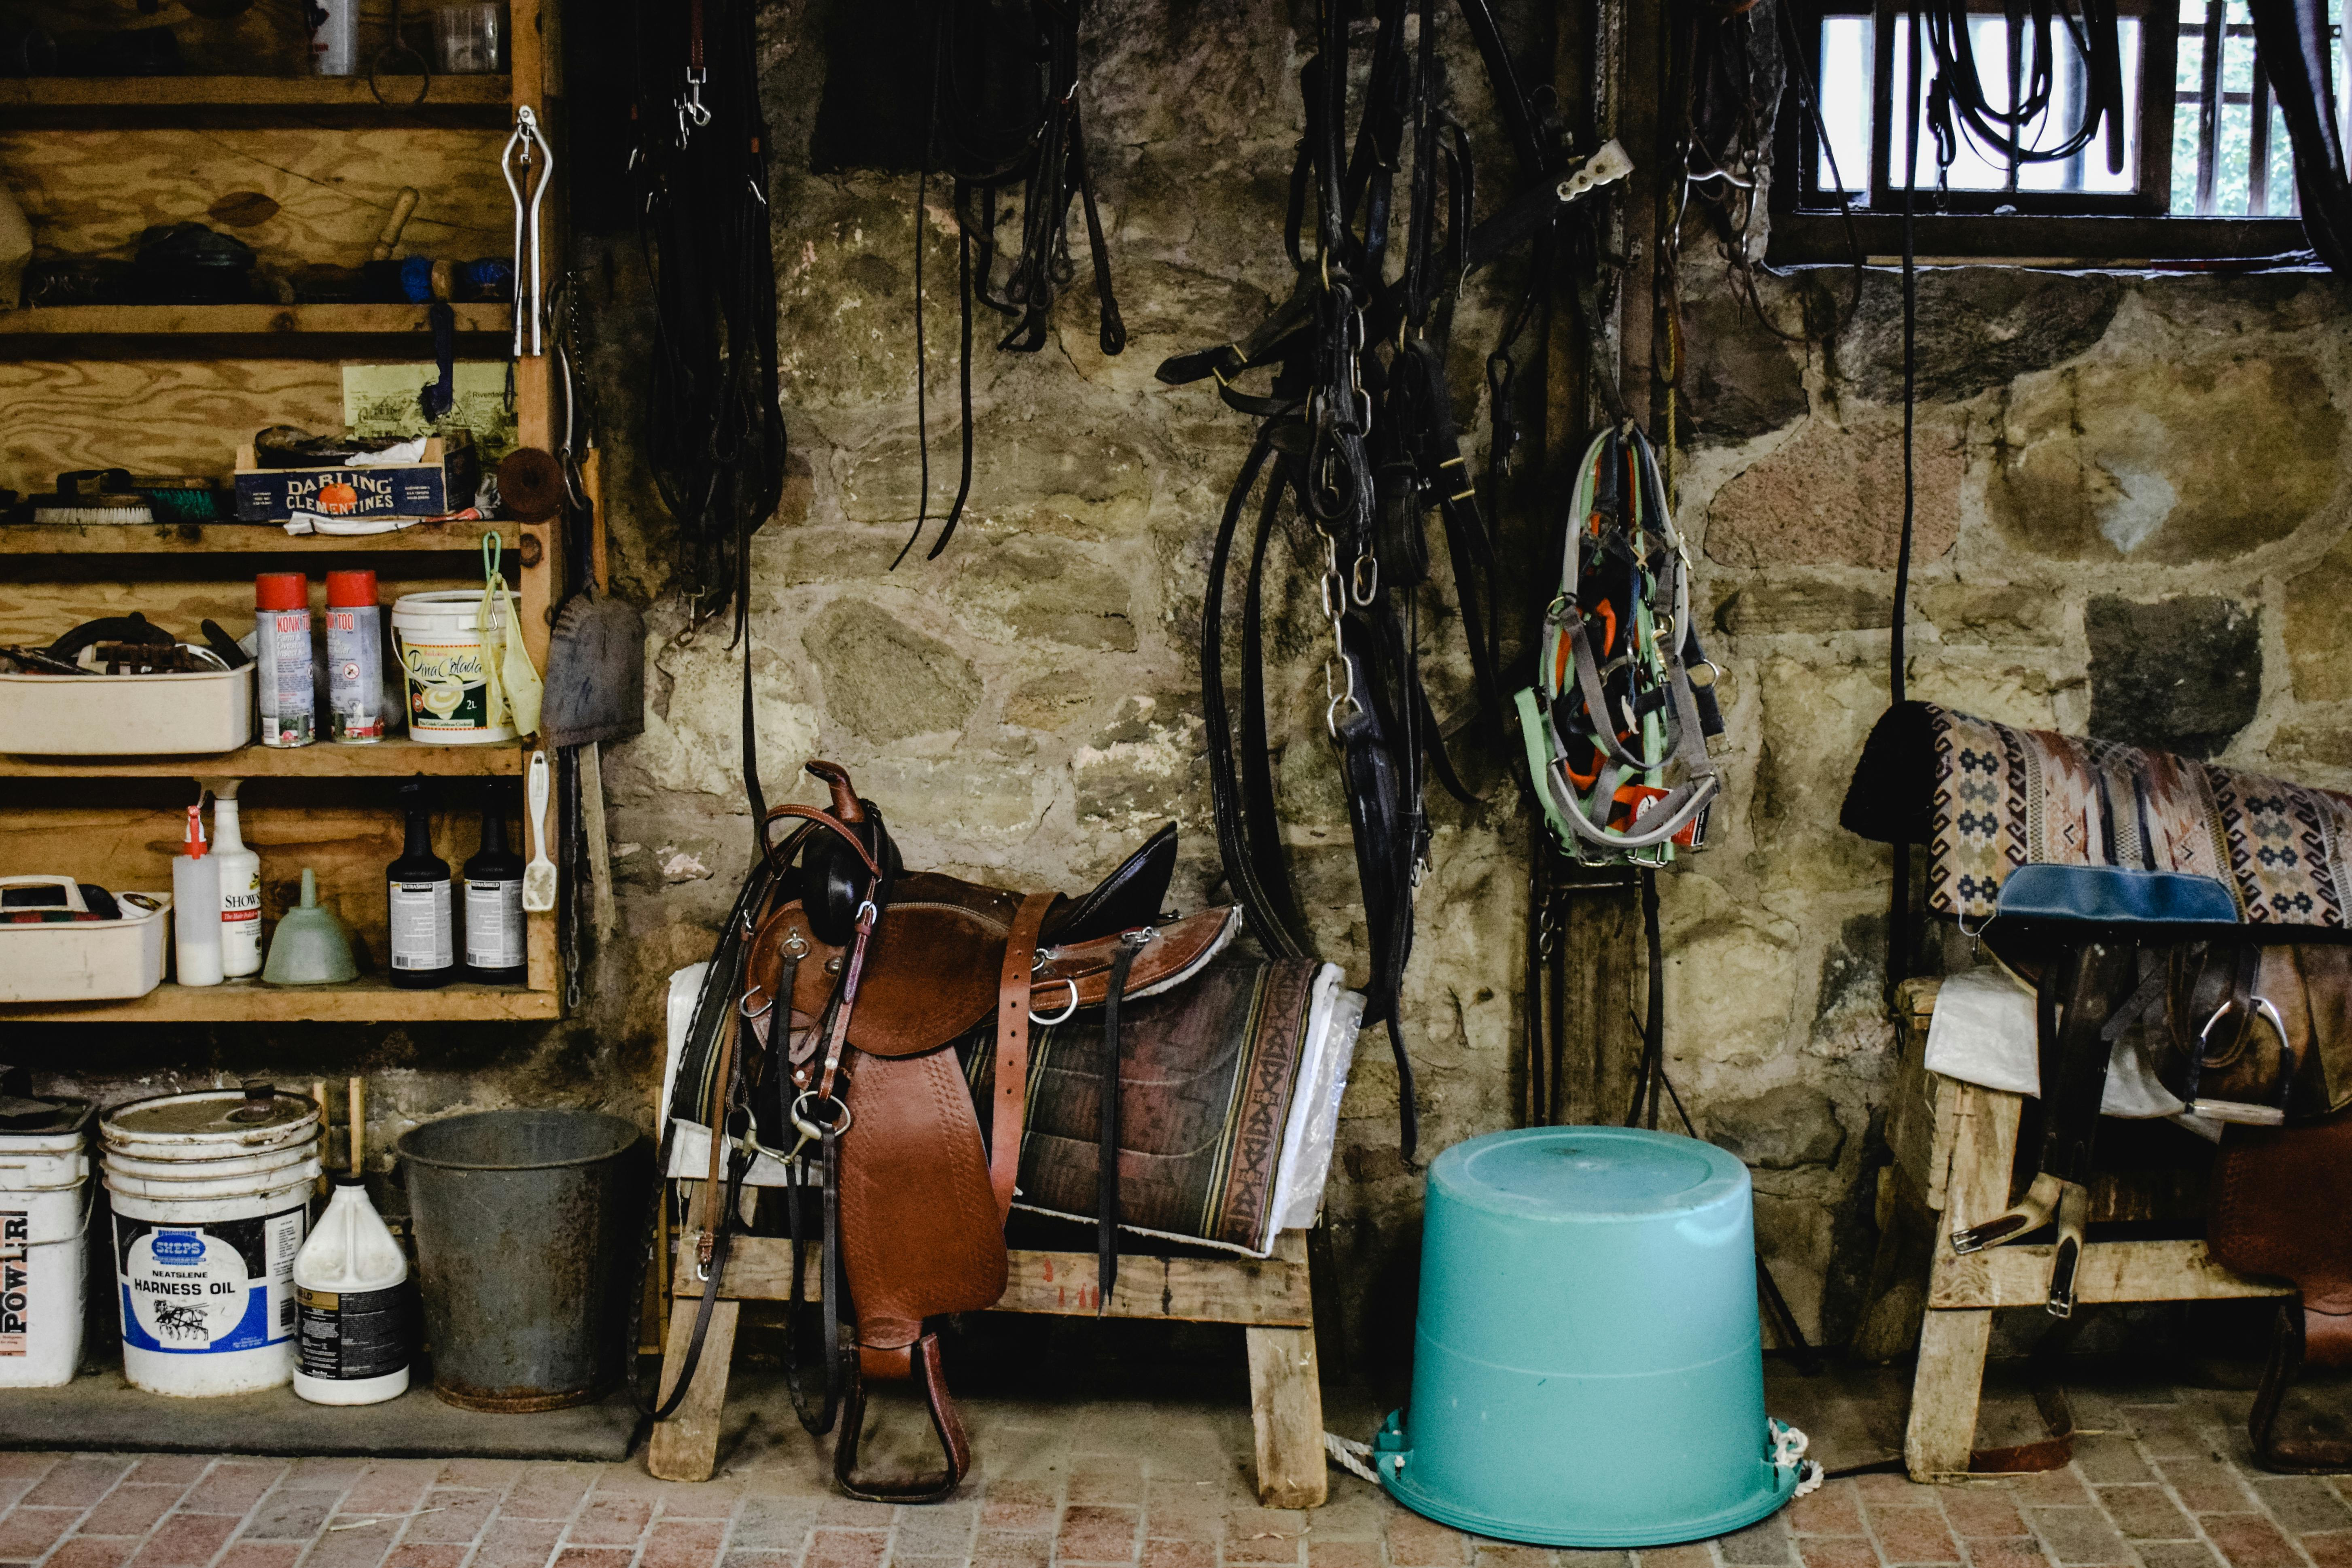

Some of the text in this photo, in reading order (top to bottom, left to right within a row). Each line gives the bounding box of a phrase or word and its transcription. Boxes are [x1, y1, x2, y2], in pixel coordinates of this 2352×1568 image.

[287, 473, 392, 495] DARLING
[286, 495, 394, 515] CLEMENTINES
[277, 616, 300, 632] KONK
[338, 614, 353, 630] TOO
[439, 655, 481, 677] Colada
[467, 700, 477, 710] 2L
[156, 1241, 200, 1254] SHEPS
[135, 1279, 235, 1295] HARNESS OIL
